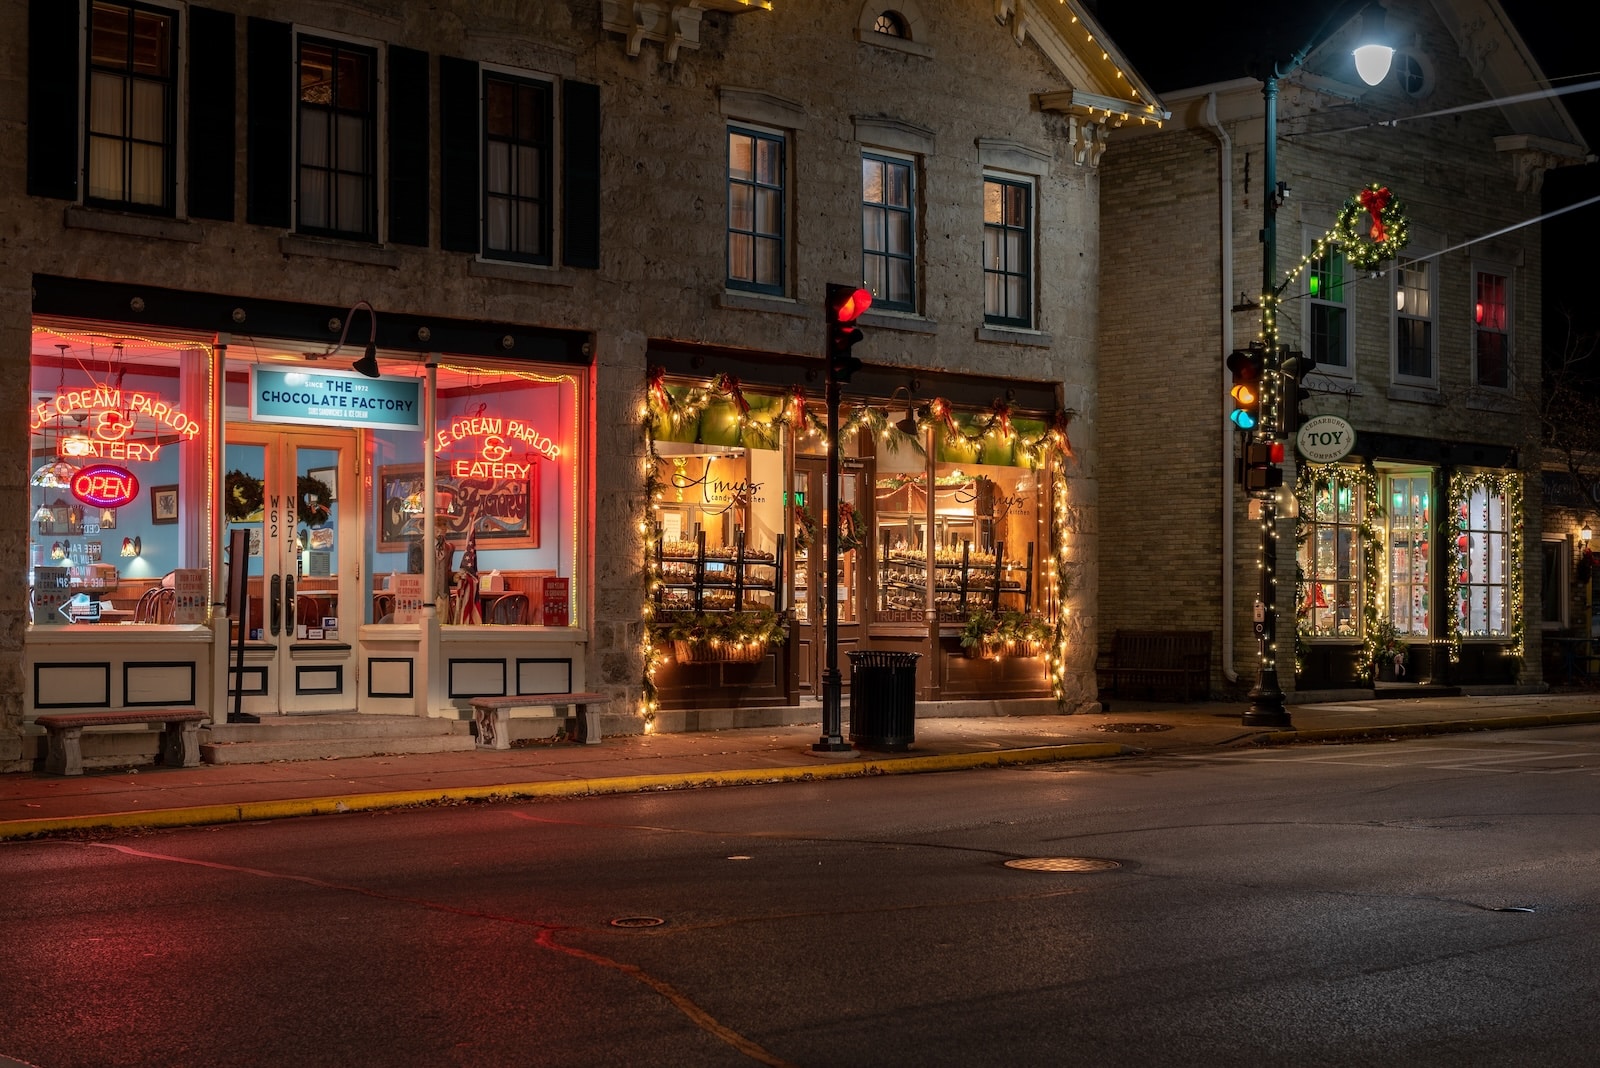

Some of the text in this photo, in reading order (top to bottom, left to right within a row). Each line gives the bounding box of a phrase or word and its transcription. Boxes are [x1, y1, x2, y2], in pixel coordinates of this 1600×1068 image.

[304, 380, 369, 393] SINCE THE 1972
[261, 390, 413, 412] CHOCOLATE FACTORY
[56, 389, 121, 415] CREAM
[130, 393, 200, 440] PARLOR
[96, 409, 134, 441] &
[1305, 417, 1346, 431] CEDARBURG
[61, 437, 161, 462] EATERY
[451, 417, 561, 462] CREAM PARLOR
[482, 434, 513, 462] &
[1307, 431, 1344, 447] TOY
[1309, 449, 1342, 460] COMPANY
[455, 460, 531, 480] EATERY
[75, 475, 133, 499] OPEN
[711, 494, 732, 503] candy
[875, 611, 923, 623] TRUFFLES
